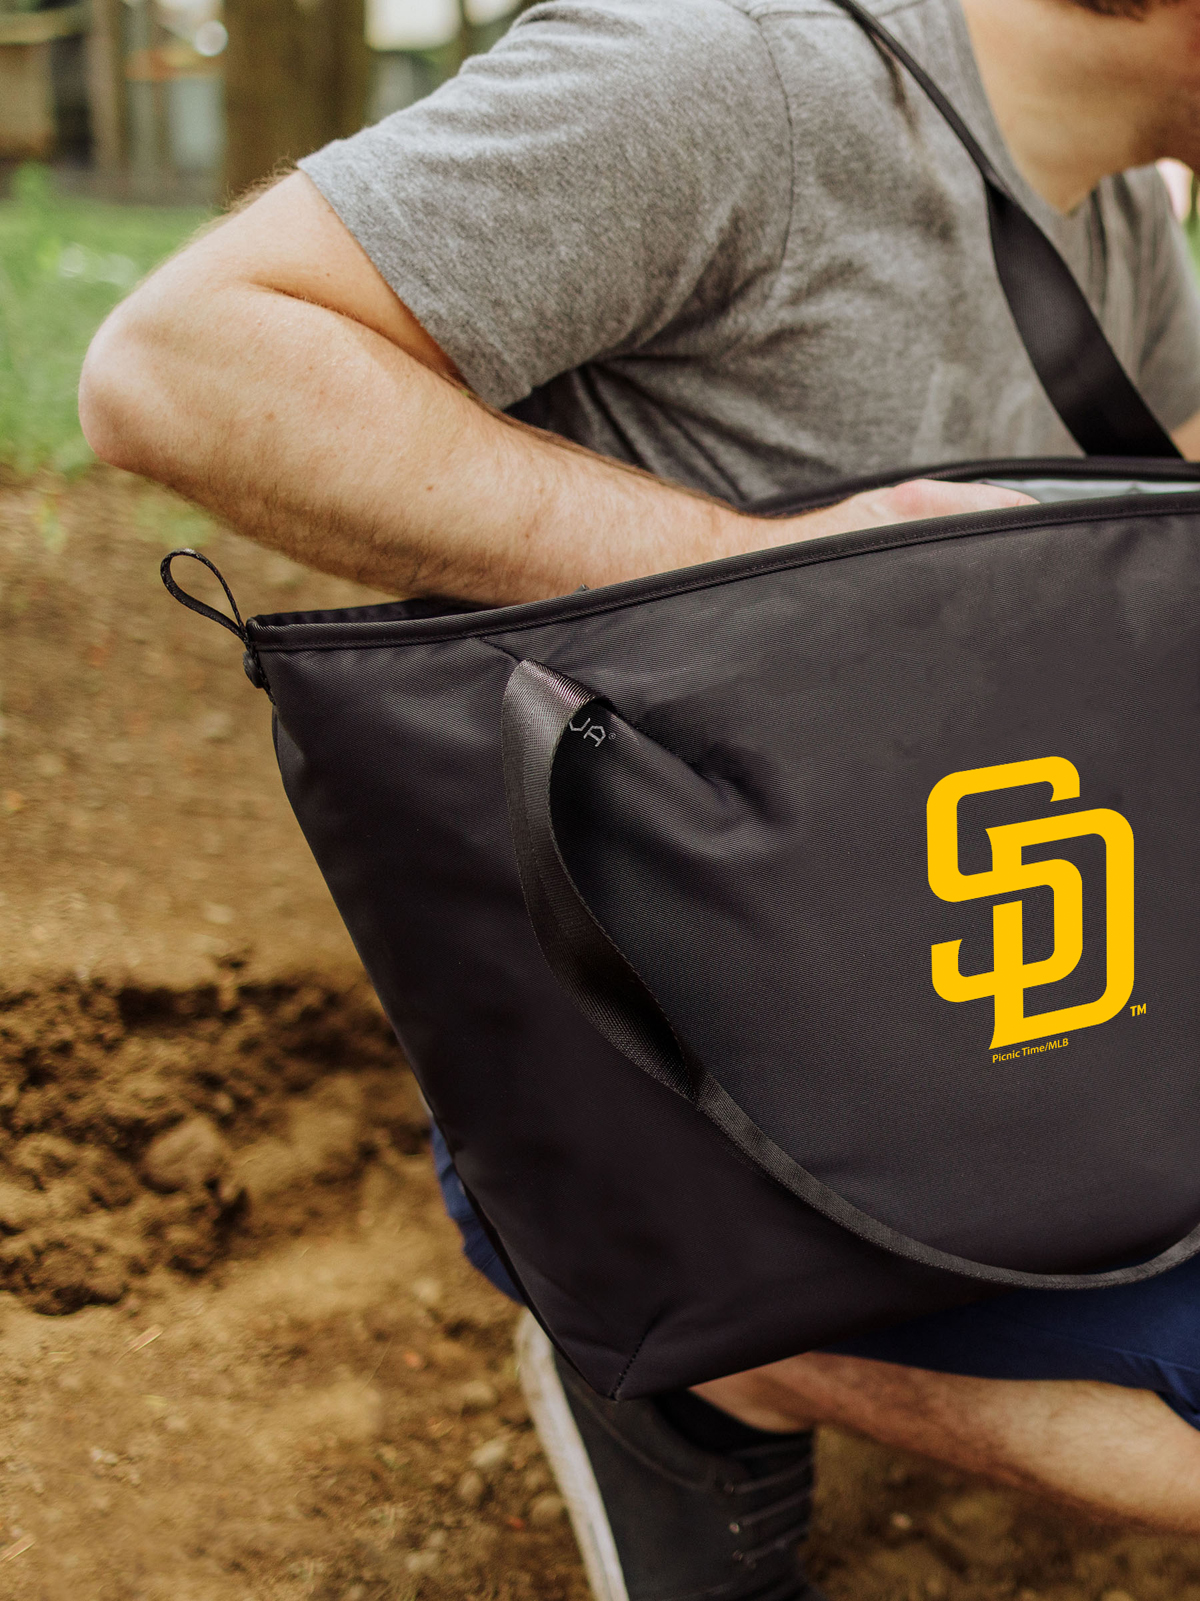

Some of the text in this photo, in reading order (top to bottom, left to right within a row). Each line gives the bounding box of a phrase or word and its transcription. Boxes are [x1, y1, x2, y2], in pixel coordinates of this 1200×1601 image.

[926, 756, 1134, 1050] SD
[1129, 1003, 1147, 1017] TM
[992, 1038, 1069, 1064] Picnic Time/MLB
